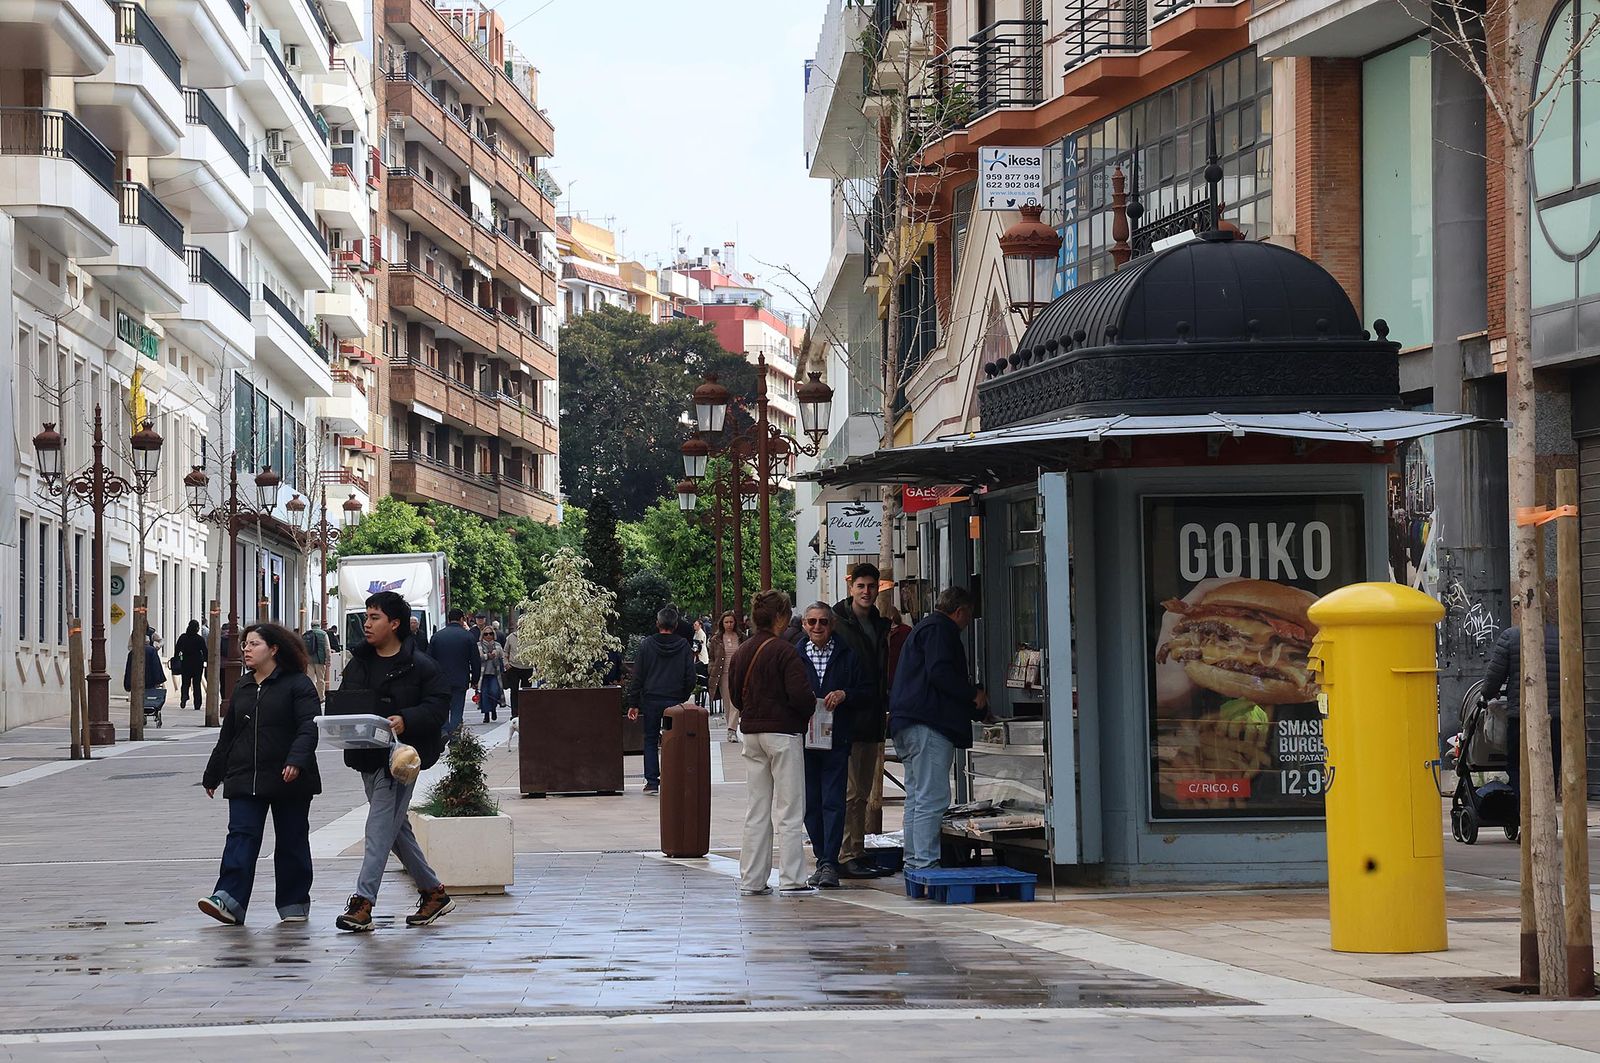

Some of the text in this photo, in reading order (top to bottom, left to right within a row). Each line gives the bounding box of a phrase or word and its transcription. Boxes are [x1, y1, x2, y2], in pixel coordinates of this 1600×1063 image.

[1008, 155, 1041, 166] ikesa
[829, 516, 882, 528] Plus Ultra
[1179, 521, 1332, 582] GOIKO
[1280, 754, 1298, 762] CON
[1189, 783, 1200, 793] C/
[1232, 783, 1239, 792] 6
[1280, 769, 1326, 797] 12,9
